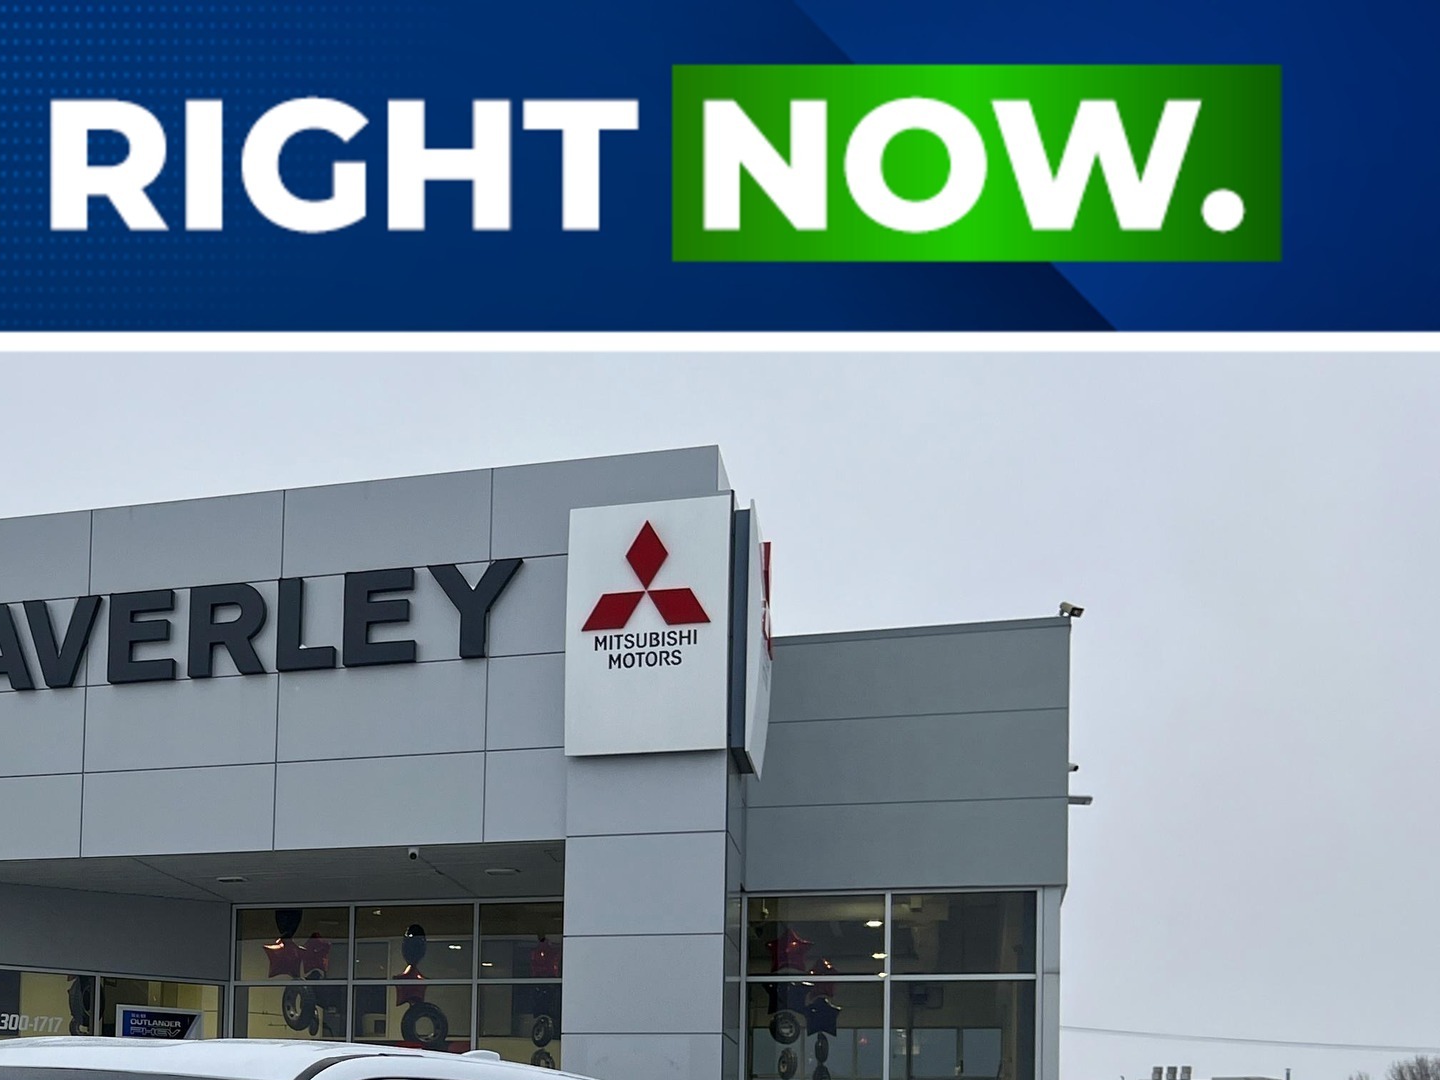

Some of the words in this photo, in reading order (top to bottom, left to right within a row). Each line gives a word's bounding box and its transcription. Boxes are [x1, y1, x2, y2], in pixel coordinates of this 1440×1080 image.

[594, 629, 698, 651] MITSUBISHI
[608, 650, 682, 669] MOTORS
[130, 1018, 181, 1028] OUTLANDER
